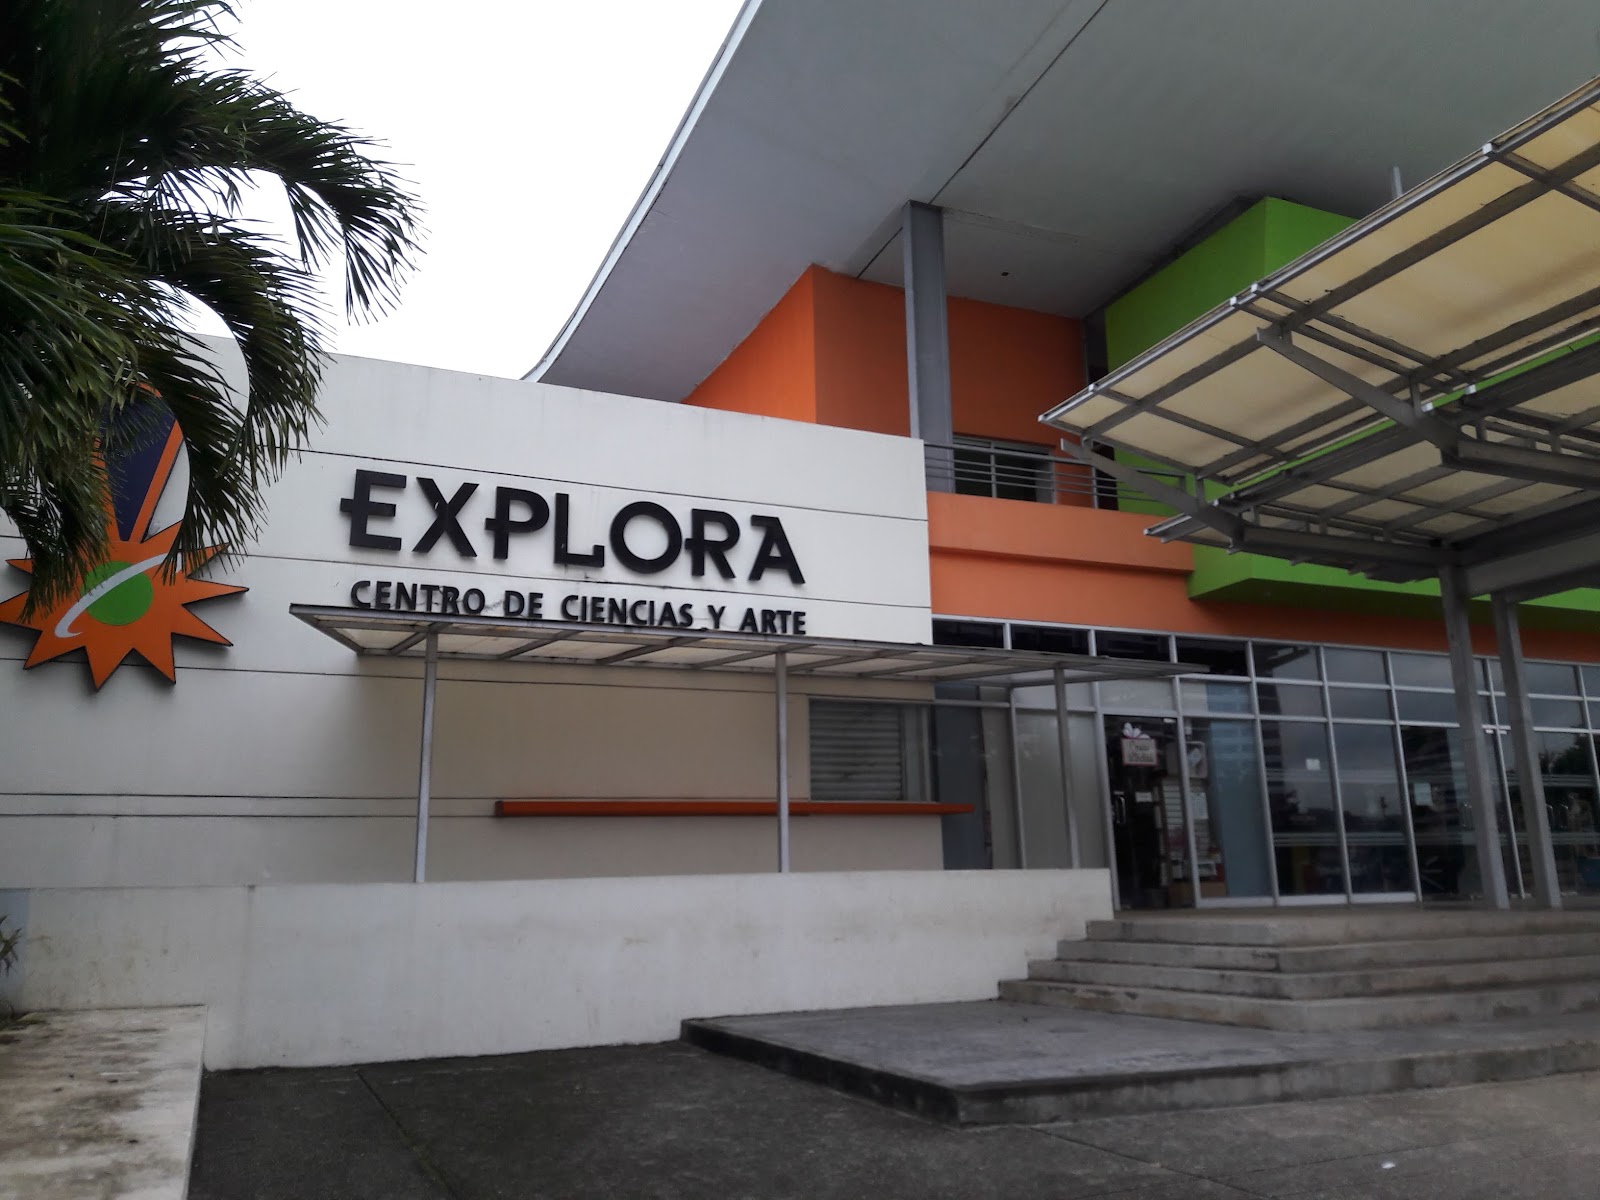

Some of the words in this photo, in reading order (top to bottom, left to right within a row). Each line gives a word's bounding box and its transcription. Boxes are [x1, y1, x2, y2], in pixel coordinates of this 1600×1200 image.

[340, 469, 806, 585] EXPLORA
[350, 580, 486, 615] CENTRO
[503, 590, 543, 618] DE
[560, 595, 694, 627] CIENCIAS
[707, 605, 726, 629] Y
[739, 607, 806, 635] ARTE
